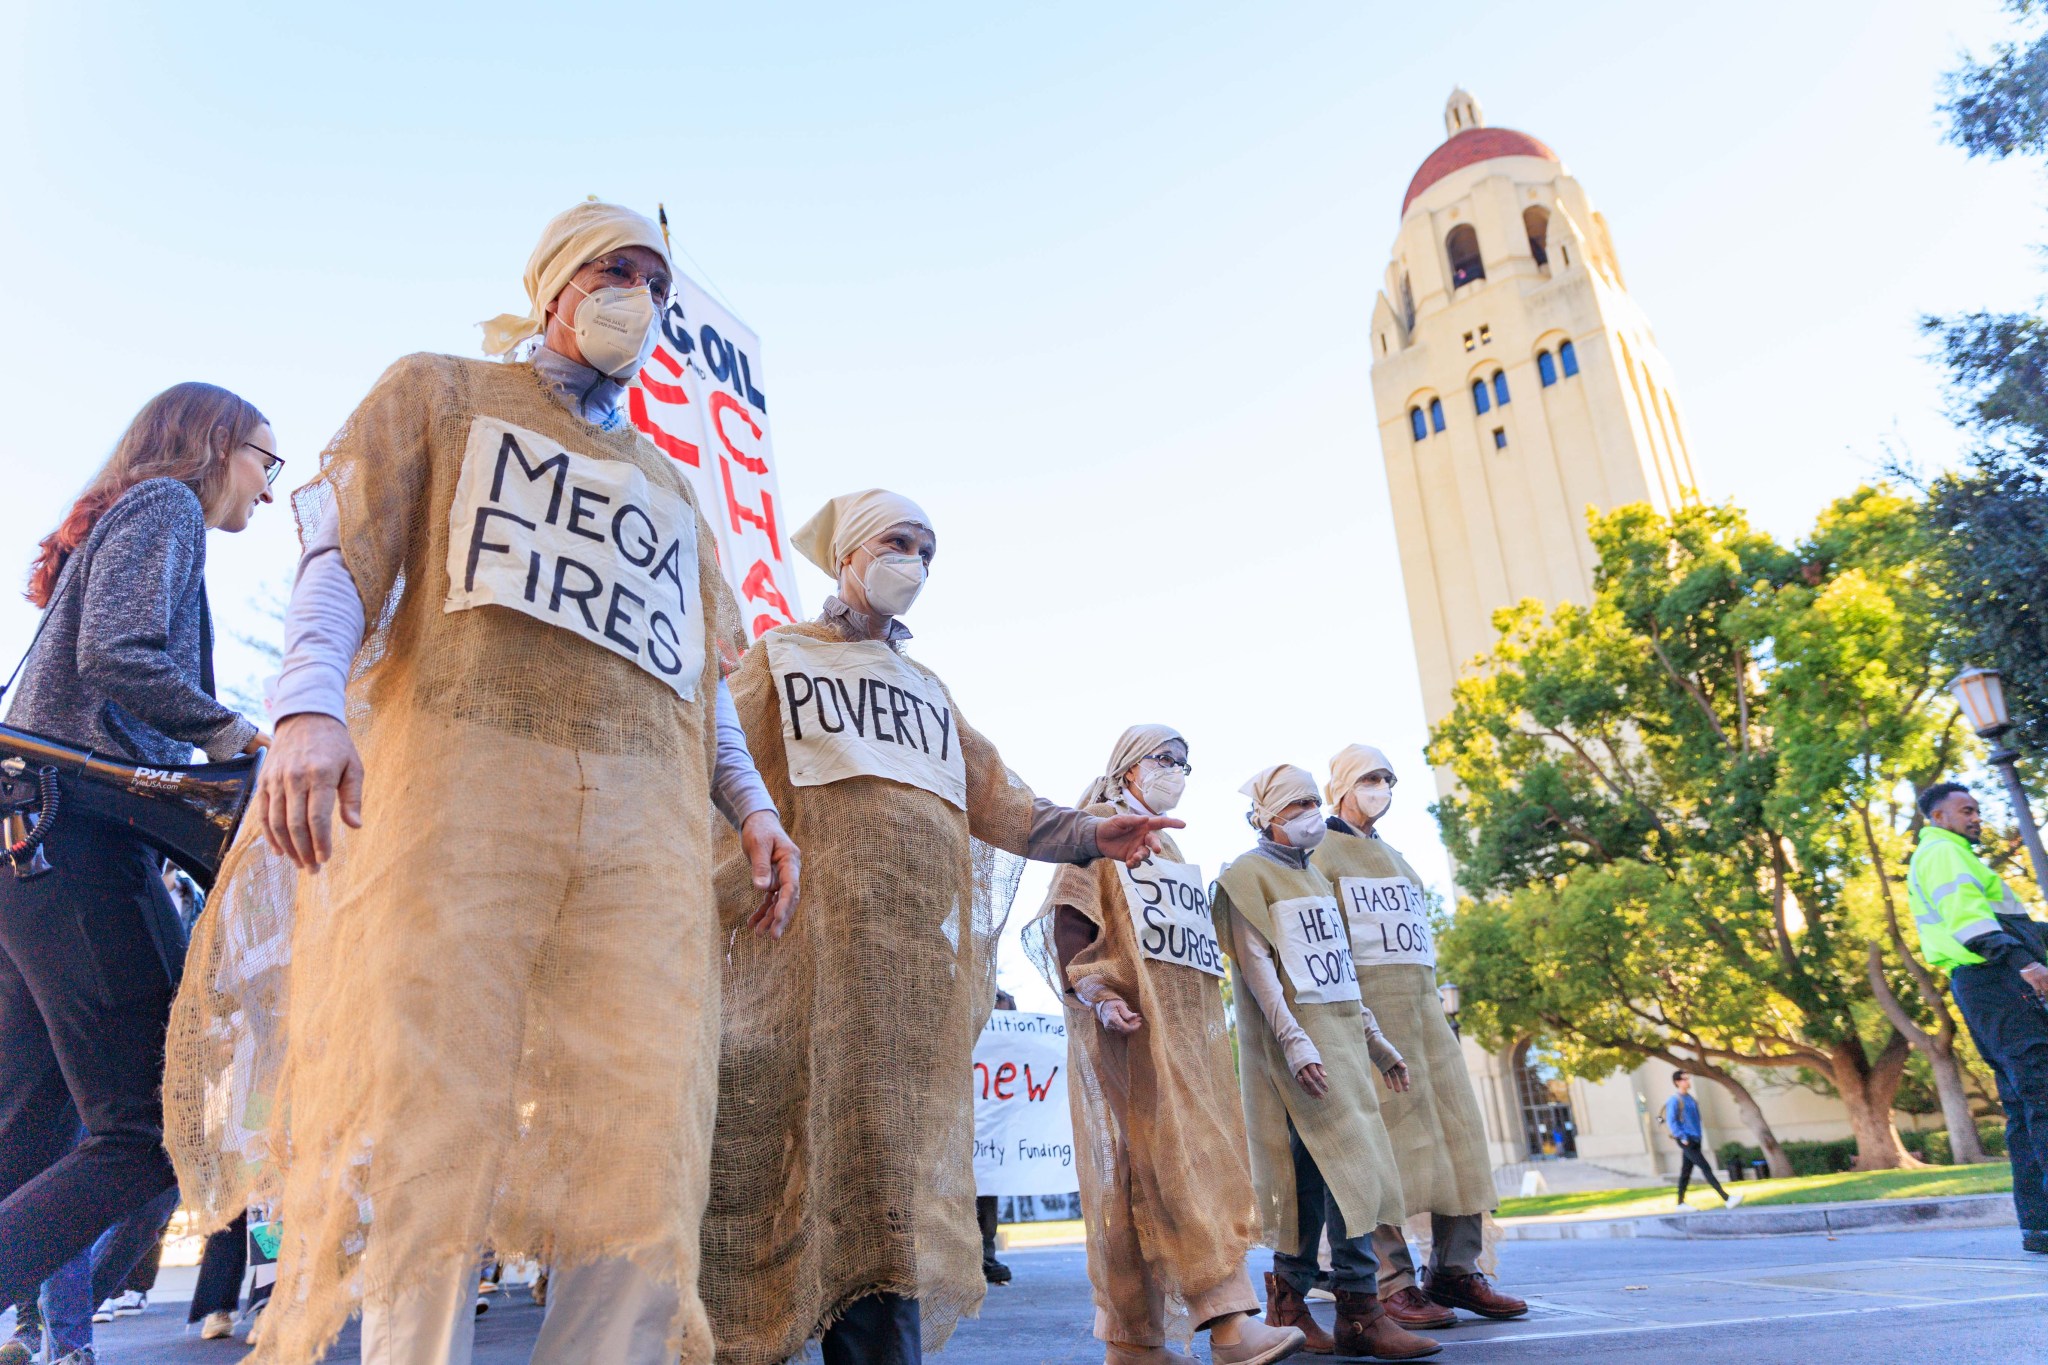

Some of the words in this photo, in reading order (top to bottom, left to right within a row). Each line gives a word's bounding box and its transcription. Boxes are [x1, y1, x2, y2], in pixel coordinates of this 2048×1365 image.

[701, 325, 767, 415] OIL
[490, 432, 686, 615] MEGA
[465, 507, 682, 675] FIRES
[784, 672, 949, 761] POVERTY
[131, 778, 179, 790] PyleUSA.com
[134, 766, 187, 782] PYLE
[1143, 906, 1225, 972] SURGE
[1380, 923, 1428, 953] LOSS
[985, 1016, 1065, 1036] litionTrue
[974, 1138, 1004, 1166] Dirty
[1019, 1138, 1071, 1166] Funding
